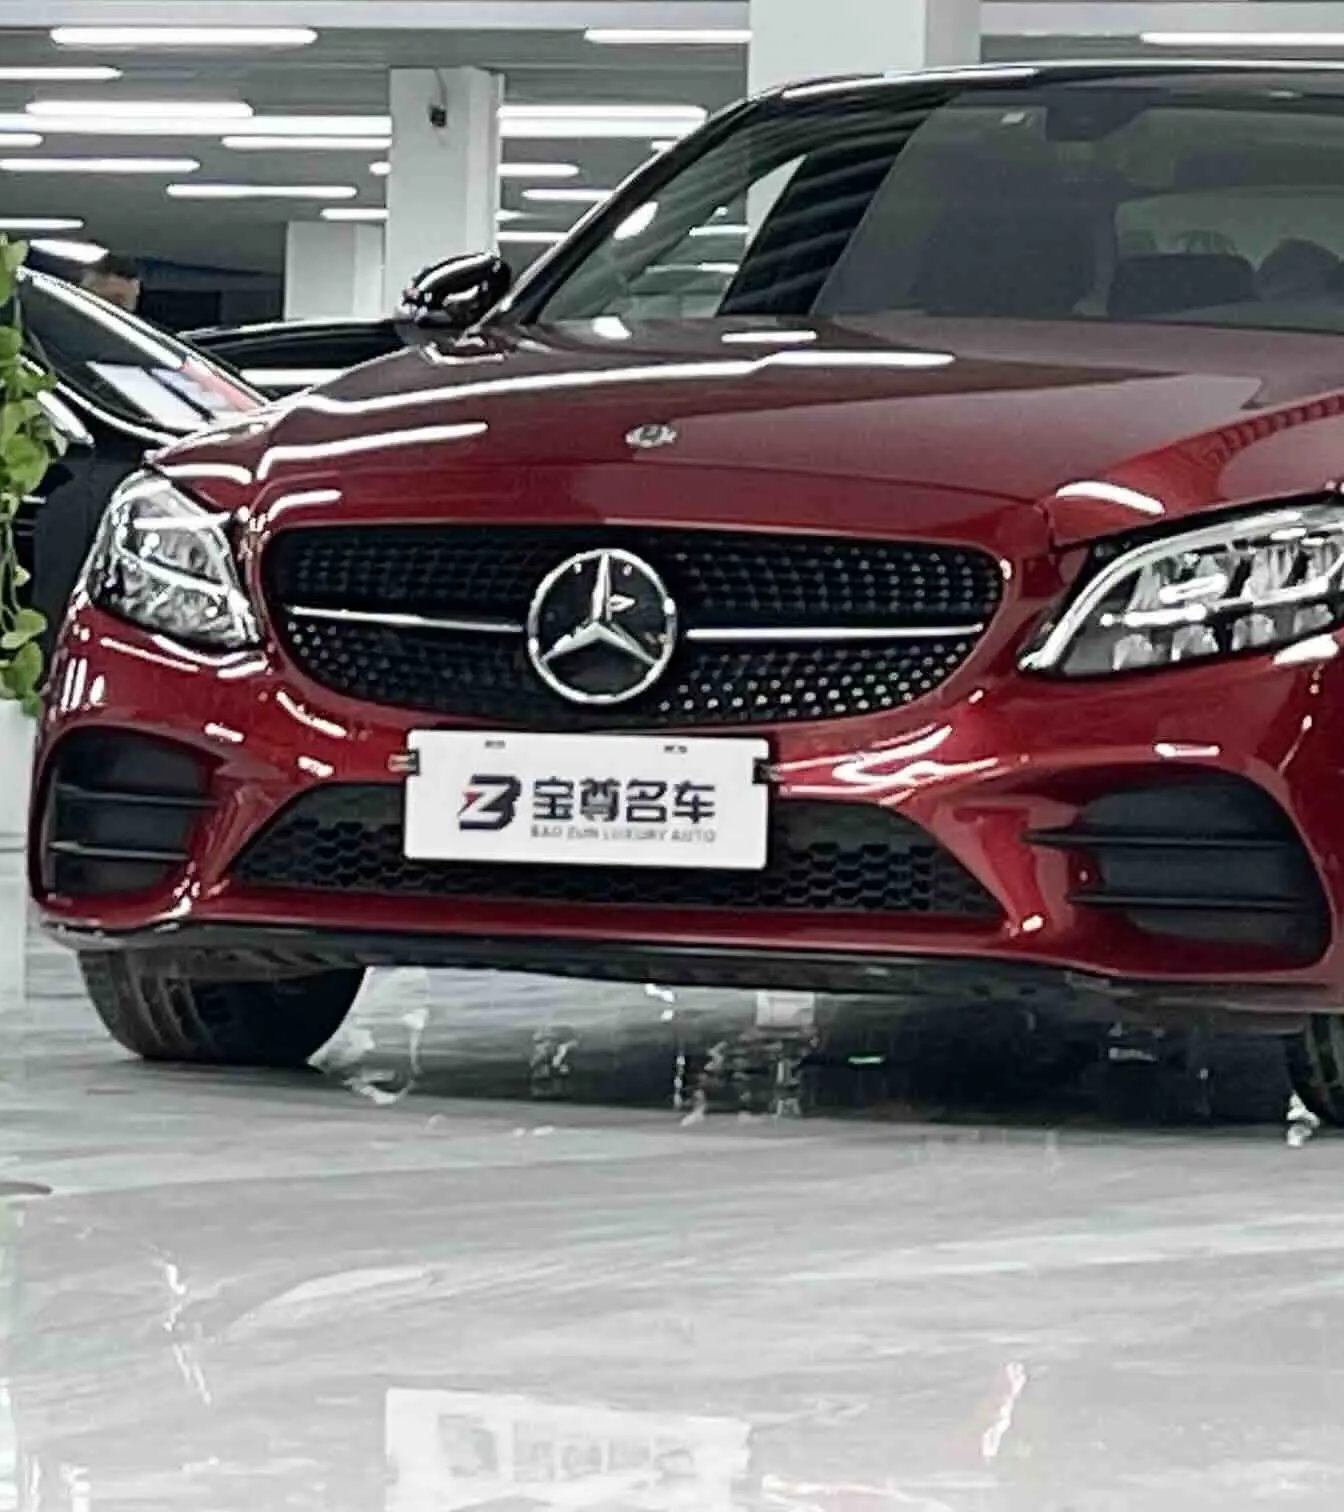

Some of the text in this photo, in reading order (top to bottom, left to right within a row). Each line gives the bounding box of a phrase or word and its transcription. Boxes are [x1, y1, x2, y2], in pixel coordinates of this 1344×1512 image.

[532, 775, 716, 824] 宝尊名车
[670, 828, 716, 843] AUTO
